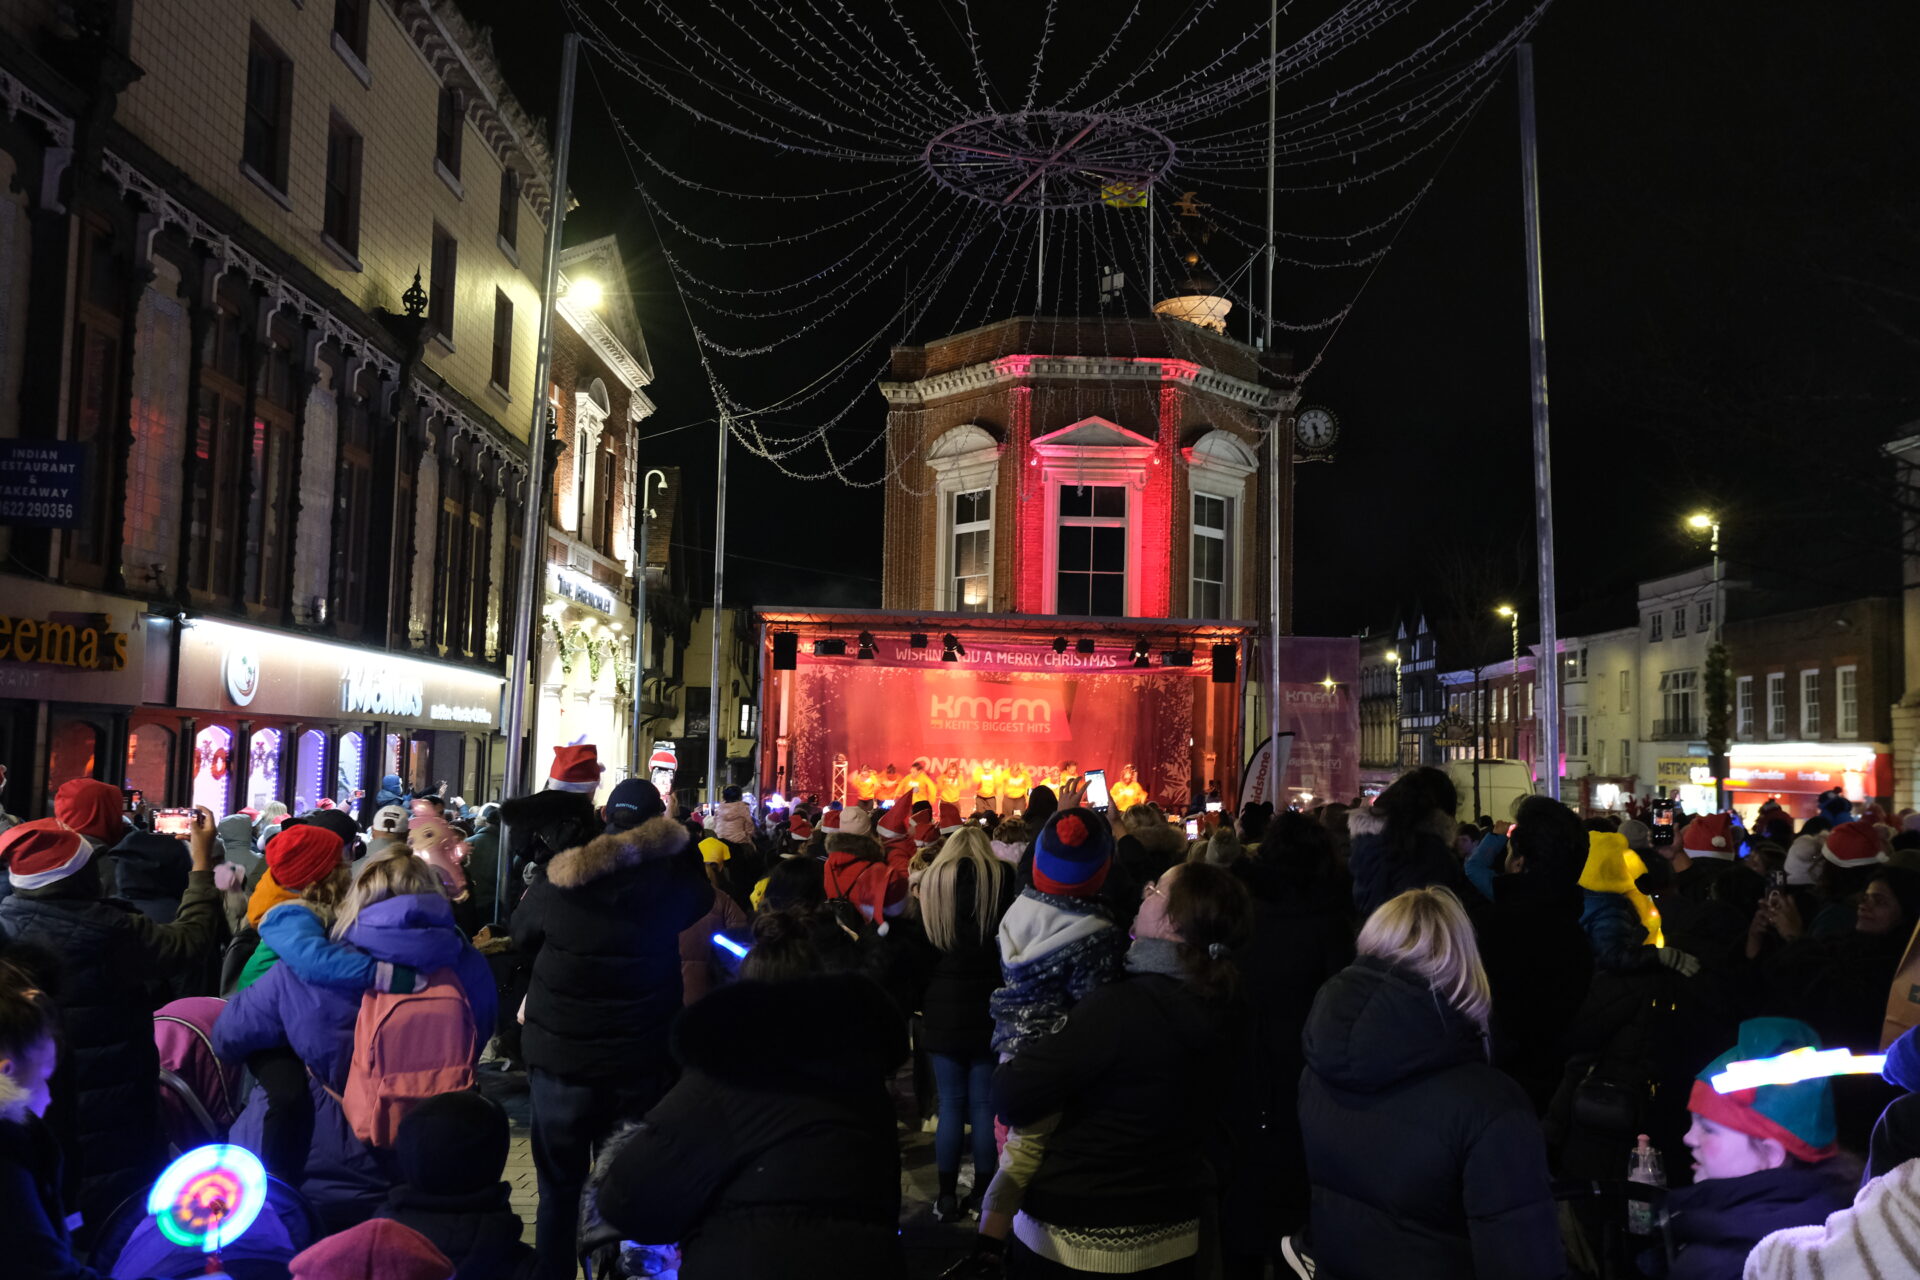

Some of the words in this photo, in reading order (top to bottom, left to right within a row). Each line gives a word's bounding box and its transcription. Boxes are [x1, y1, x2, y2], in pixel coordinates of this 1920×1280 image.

[12, 448, 58, 460] INDIAN
[27, 502, 73, 519] 290356
[895, 647, 943, 662] WISHIN
[984, 651, 993, 663] A
[996, 652, 1041, 665] MERRY
[944, 719, 979, 731] KENT'S
[981, 721, 1024, 732] BIGGEST
[1027, 723, 1051, 733] HITS
[1657, 761, 1688, 775] METRO
